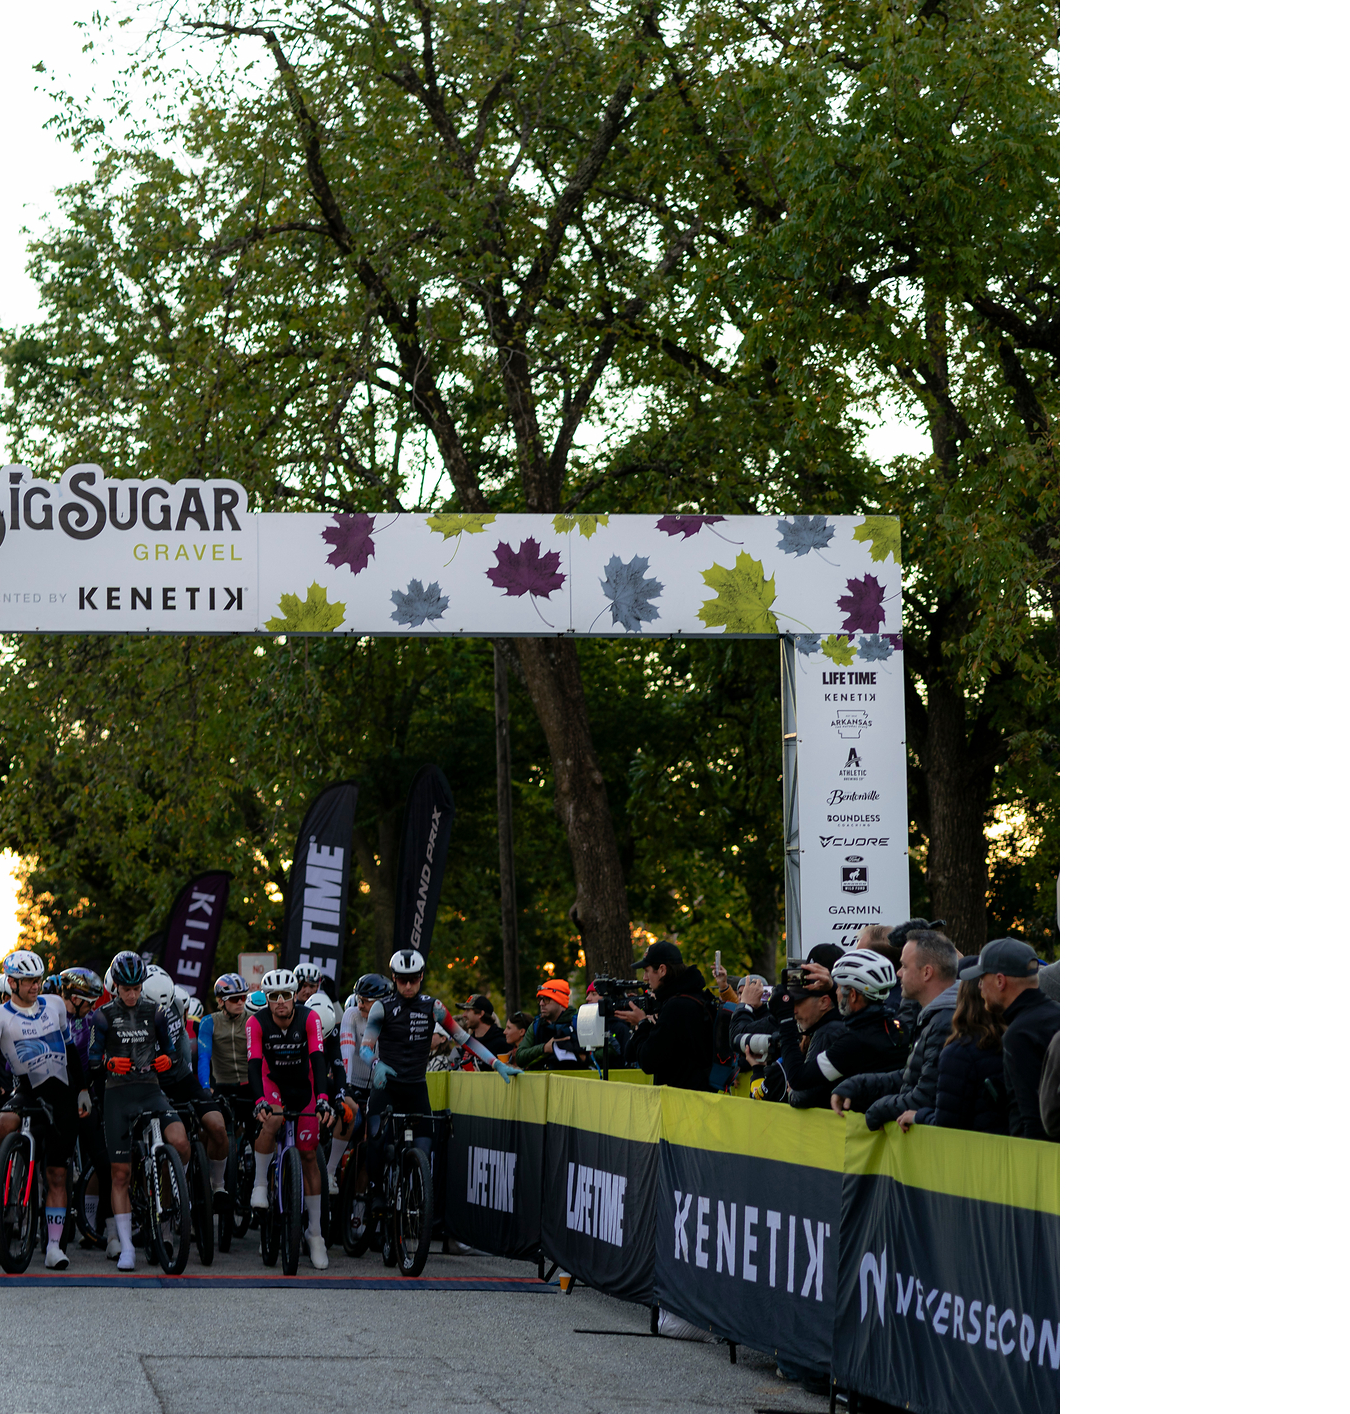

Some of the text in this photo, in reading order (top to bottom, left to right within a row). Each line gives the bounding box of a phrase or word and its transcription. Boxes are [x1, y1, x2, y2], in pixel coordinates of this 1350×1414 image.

[59, 472, 242, 540] SUGAR
[133, 544, 242, 560] GRAVEL
[49, 593, 67, 603] BY
[79, 587, 242, 610] KENETIK
[824, 693, 876, 701] KENETIK
[831, 718, 873, 727] ARKANSAS
[832, 837, 890, 846] CUORE
[410, 805, 442, 949] GRAND PRIX
[828, 906, 881, 914] GARMIN
[841, 936, 859, 946] Li
[253, 965, 264, 974] NO
[674, 1190, 825, 1301] KENETIK
